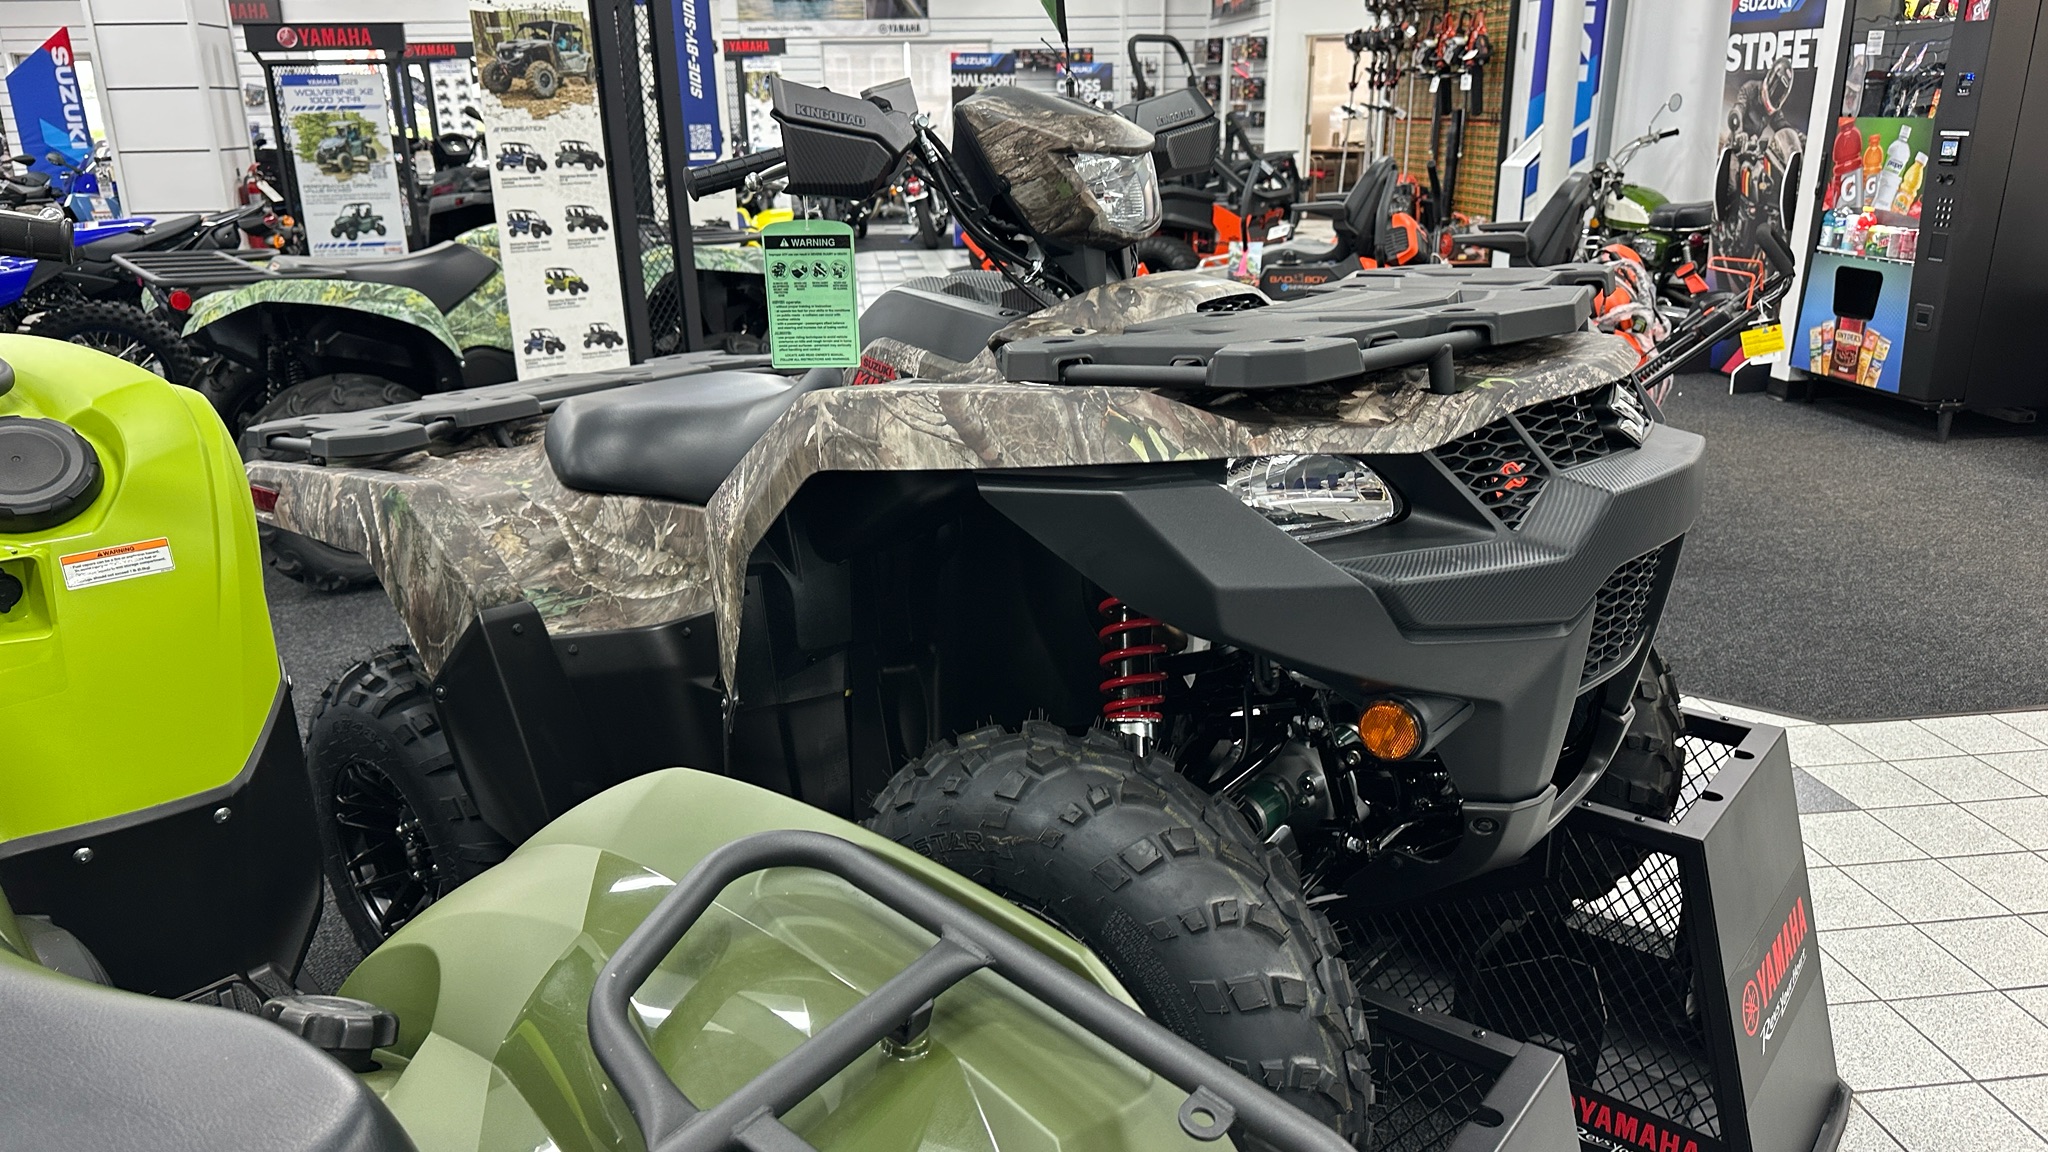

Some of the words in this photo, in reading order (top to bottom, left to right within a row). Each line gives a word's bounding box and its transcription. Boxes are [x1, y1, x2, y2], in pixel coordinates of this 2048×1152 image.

[1738, 0, 1792, 13] SUZUKI
[889, 23, 921, 33] YAMAHA
[297, 27, 373, 47] YAMAHA
[413, 44, 457, 56] YAMAHA
[729, 41, 770, 52] YAMAHA
[1725, 28, 1824, 72] STREET
[954, 55, 993, 65] SUZUKI
[951, 73, 1017, 87] DUALSPORT
[1056, 78, 1101, 93] COSS
[50, 45, 88, 149] SUZUKI
[293, 87, 356, 96] WOLVERINE
[309, 96, 333, 104] 1000
[795, 103, 867, 127] KINGQUAD
[501, 125, 547, 133] RECREATION
[791, 238, 836, 247] WARNING
[863, 357, 893, 377] SUZUKI
[103, 546, 135, 556] WARNING
[912, 829, 986, 857] STAR
[1756, 896, 1808, 1009] YAMAHA
